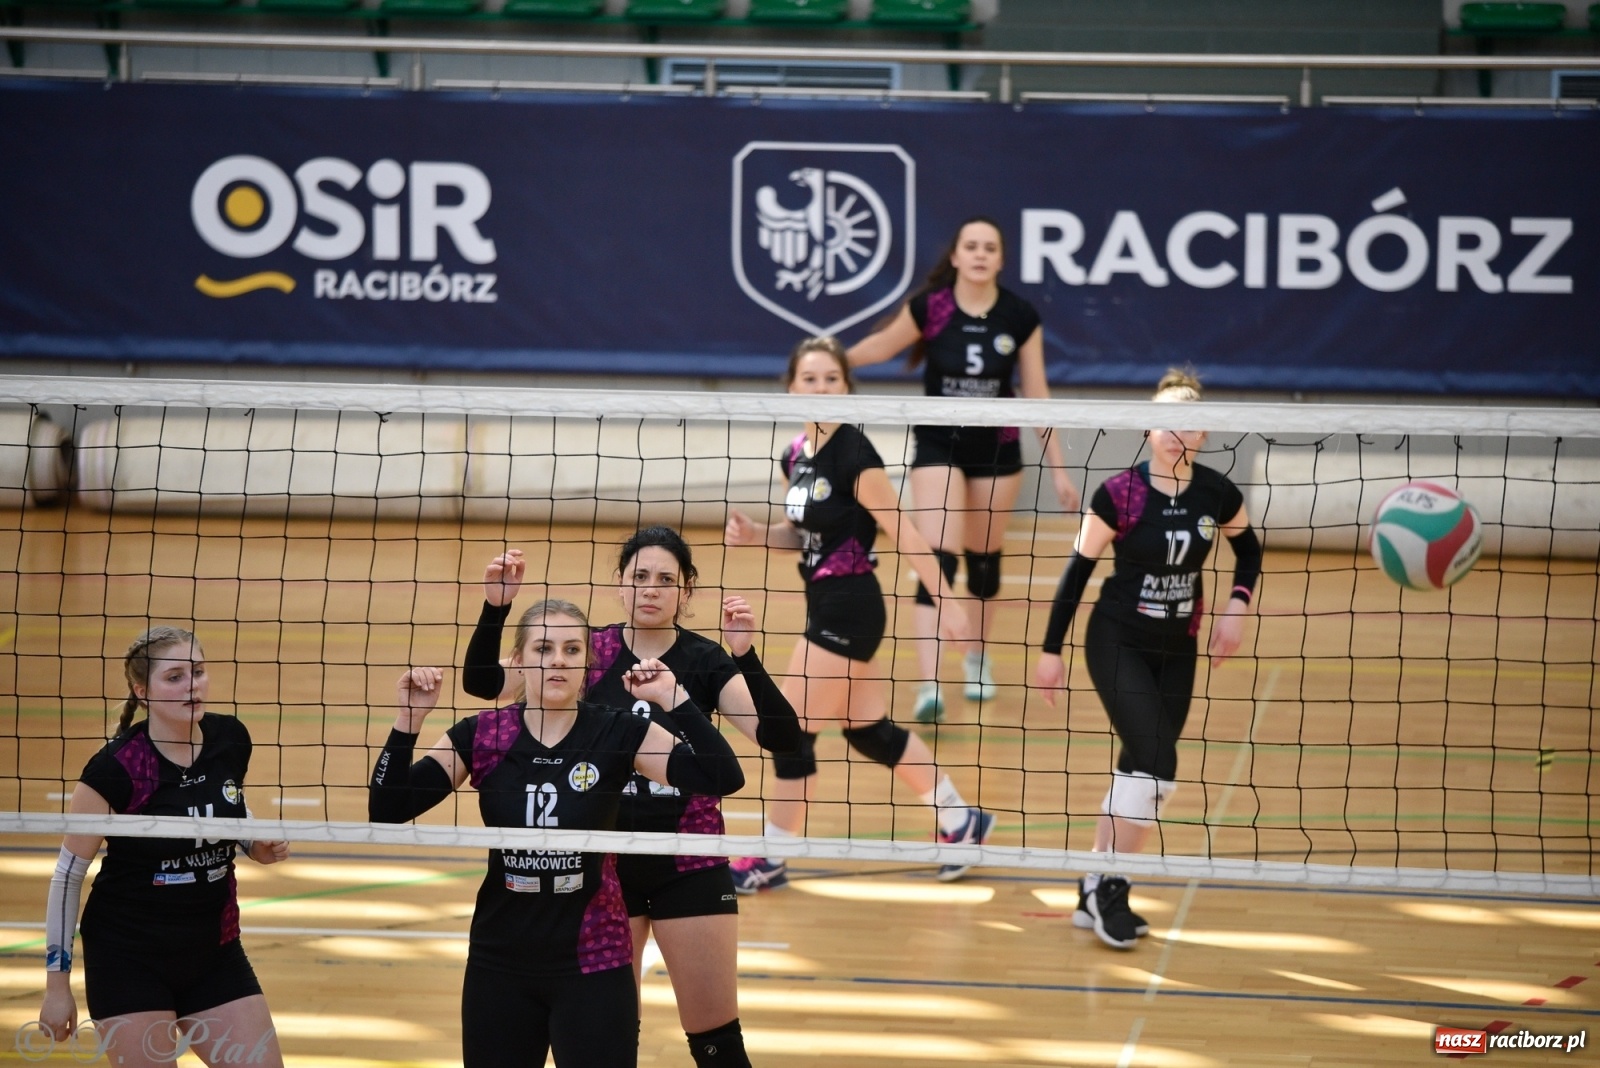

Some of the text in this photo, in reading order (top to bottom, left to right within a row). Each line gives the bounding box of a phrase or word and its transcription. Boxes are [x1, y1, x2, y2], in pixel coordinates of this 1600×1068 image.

[1020, 187, 1573, 294] RACIBÓRZ
[314, 264, 498, 302] RACIBÓRZ
[965, 343, 984, 375] 5
[1165, 530, 1191, 565] 17
[375, 750, 391, 786] ALLSIX
[525, 782, 559, 827] 12
[161, 858, 181, 871] PV
[503, 855, 582, 870] KRAPKOWICE
